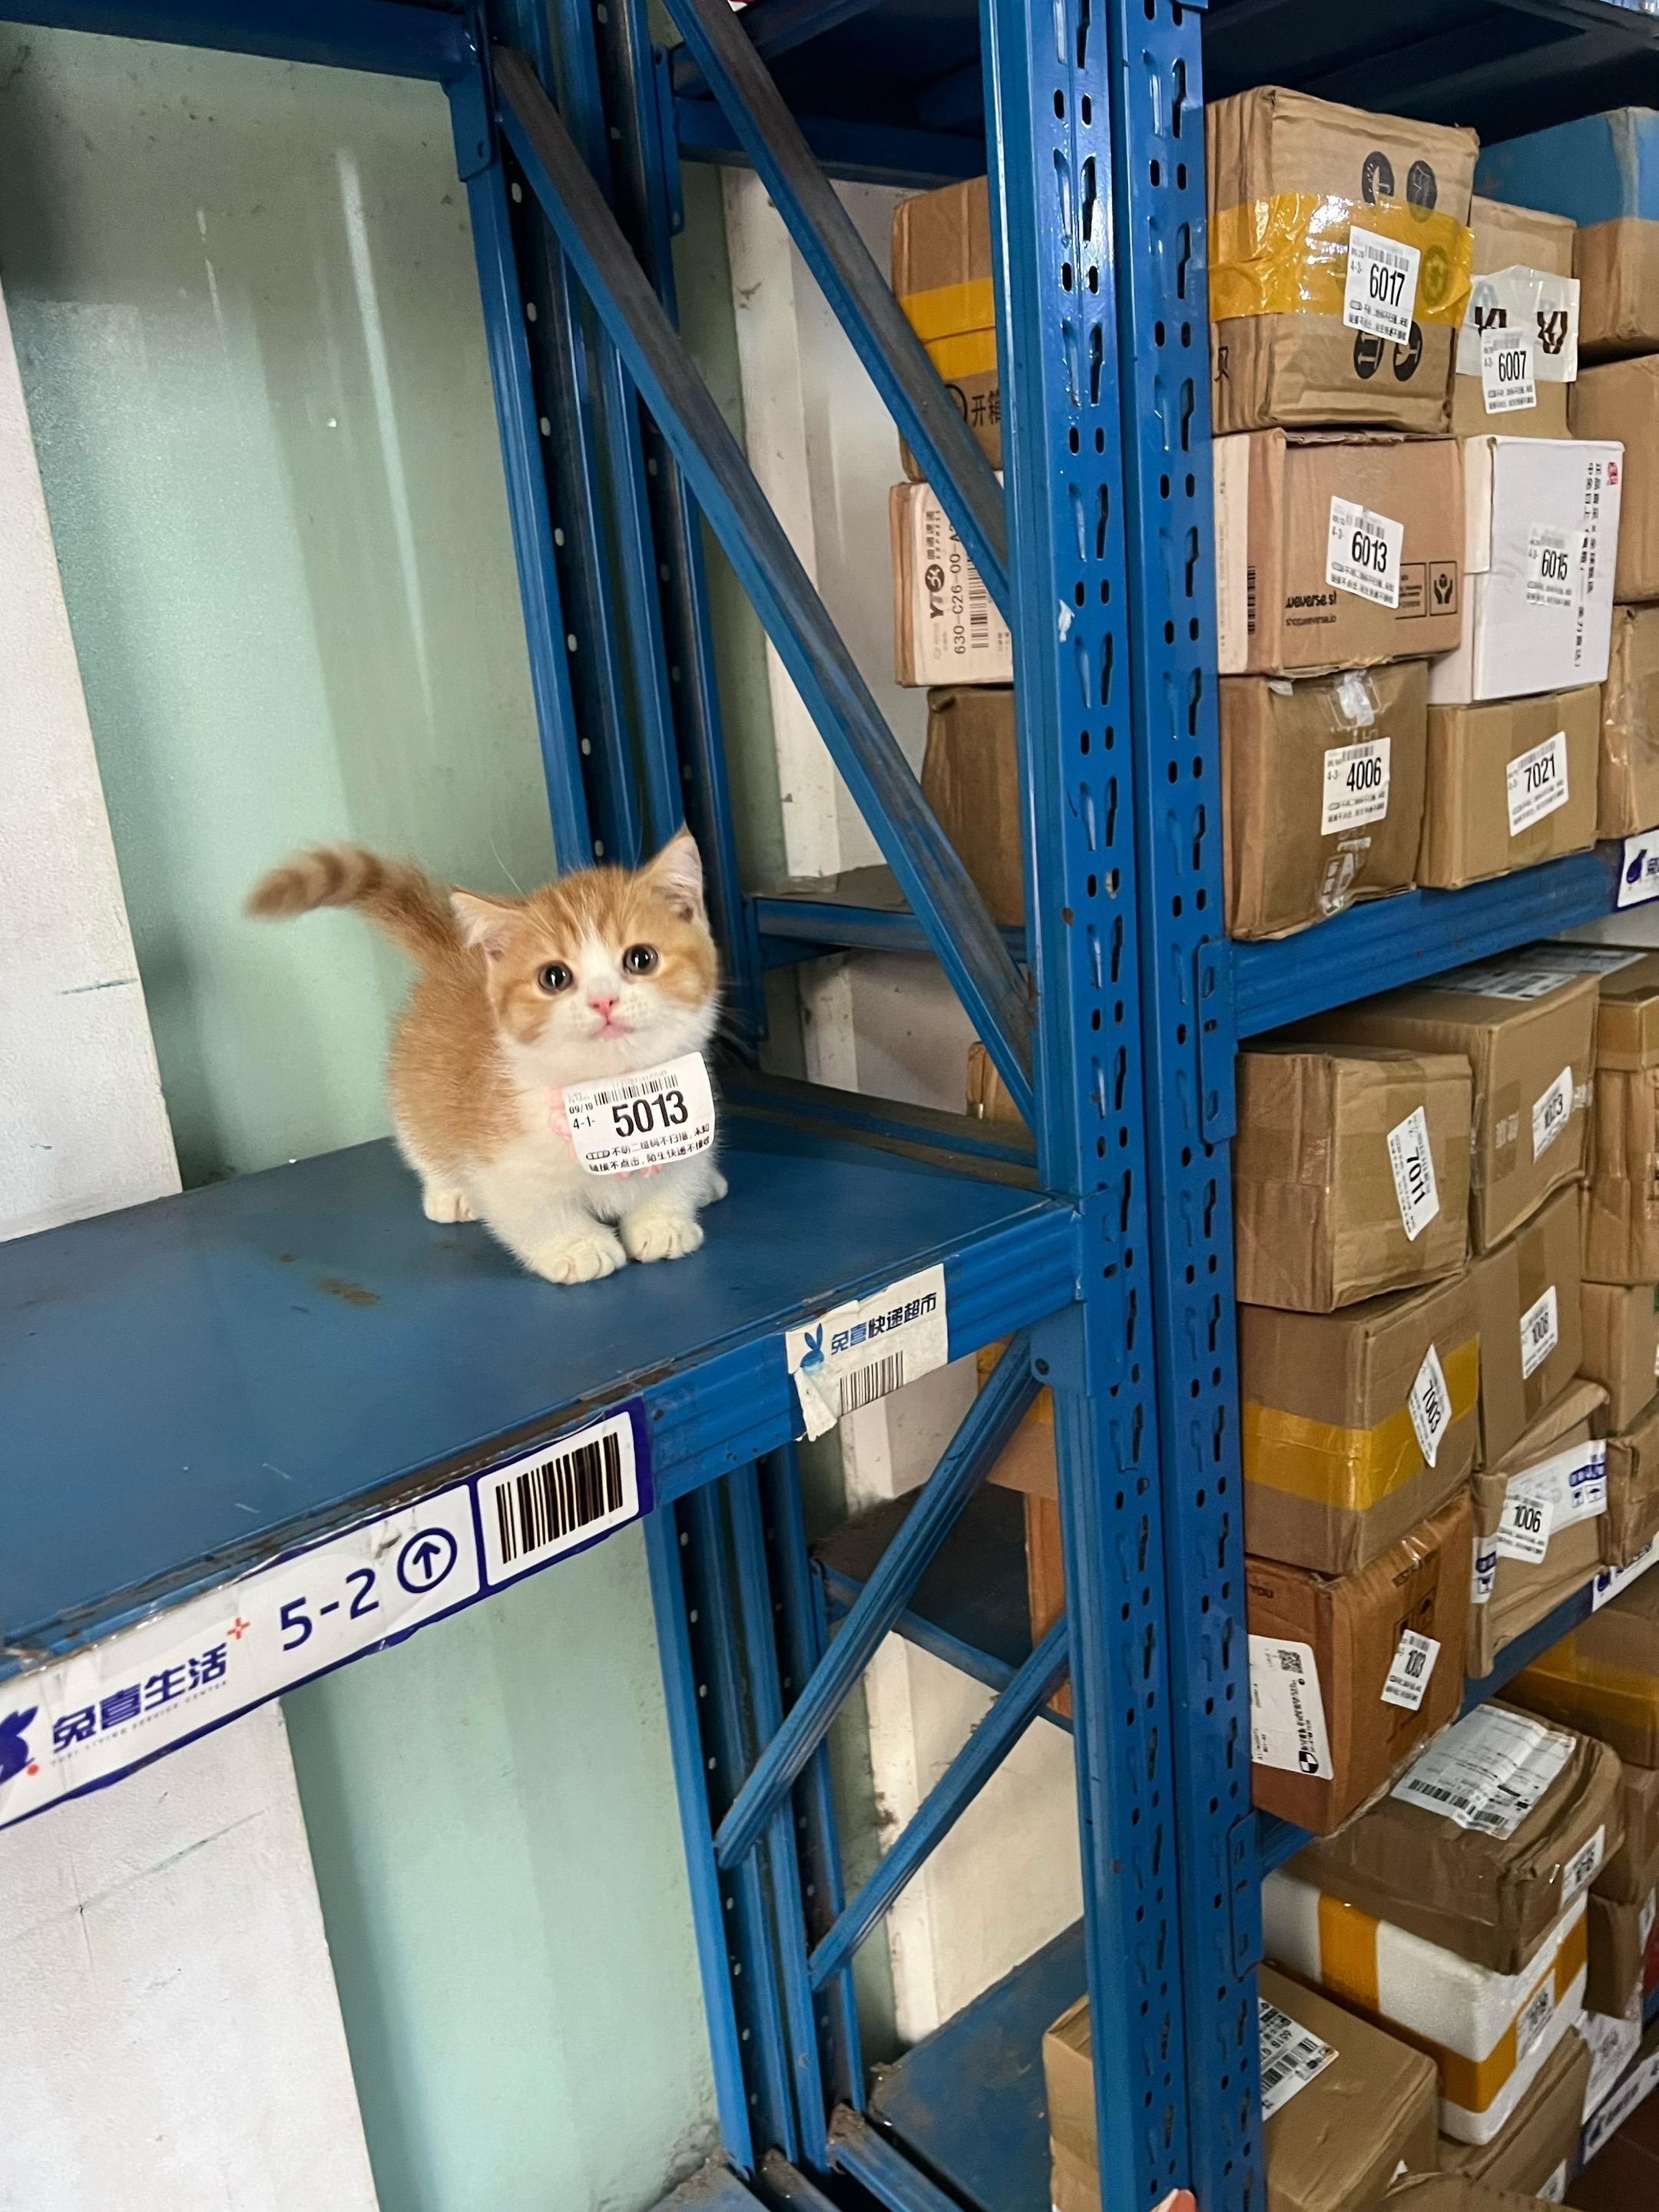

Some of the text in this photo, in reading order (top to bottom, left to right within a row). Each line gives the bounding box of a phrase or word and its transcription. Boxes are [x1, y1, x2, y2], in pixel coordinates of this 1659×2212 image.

[1369, 263, 1406, 307] 6017
[1498, 350, 1527, 382] 6007
[1351, 530, 1387, 573] 6013
[1541, 548, 1568, 581] 6015
[1346, 757, 1382, 792] 4006
[1524, 753, 1556, 793] 7021
[569, 1101, 594, 1114] 09/19
[611, 1090, 689, 1137] 5013
[1406, 1147, 1426, 1205] 7011
[1422, 1379, 1441, 1434] 7003
[1514, 1504, 1543, 1533] 1006
[280, 1568, 379, 1651] 5-2
